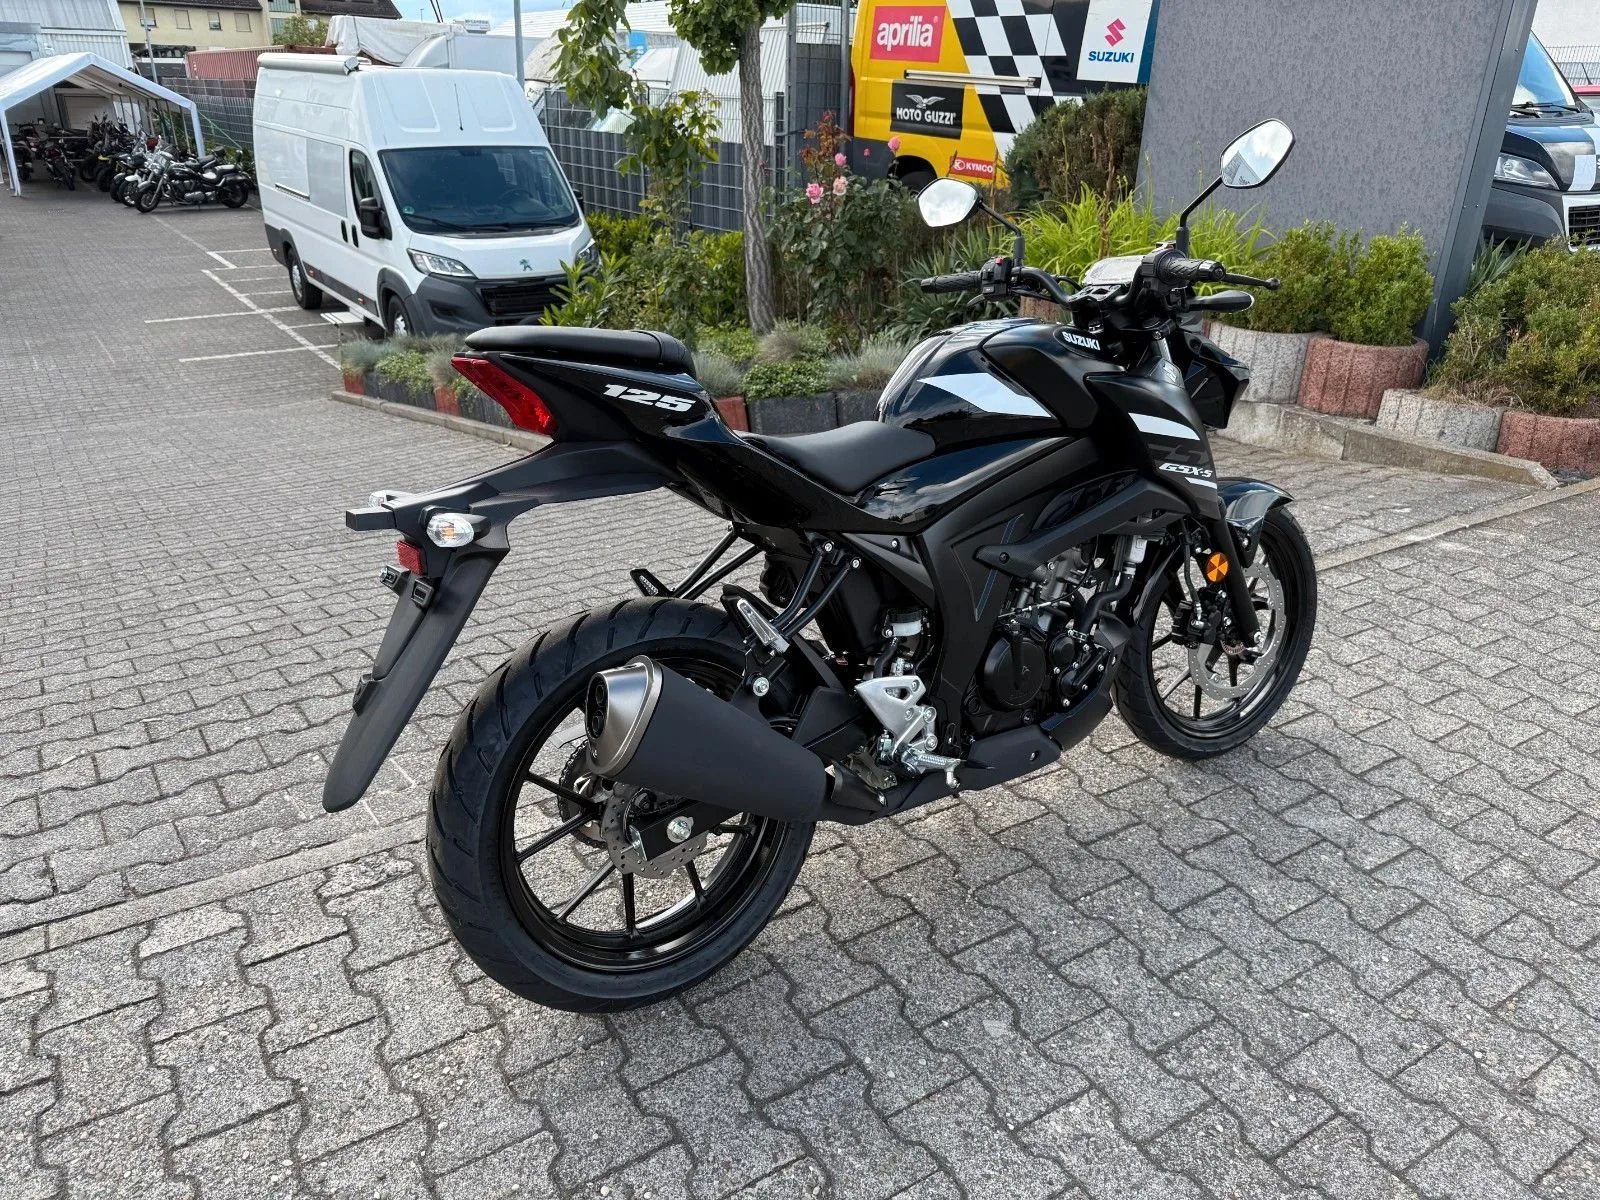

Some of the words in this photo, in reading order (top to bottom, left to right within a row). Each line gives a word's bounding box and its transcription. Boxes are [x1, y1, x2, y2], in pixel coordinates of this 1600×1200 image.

[876, 15, 934, 52] aprilia
[1088, 51, 1135, 63] SUZUKI
[896, 107, 922, 121] MOTO
[924, 110, 954, 125] GUZZI
[966, 162, 993, 173] KYMCO
[1062, 331, 1101, 351] SUZUKI
[603, 384, 697, 412] 125
[1159, 462, 1213, 478] GSX-S
